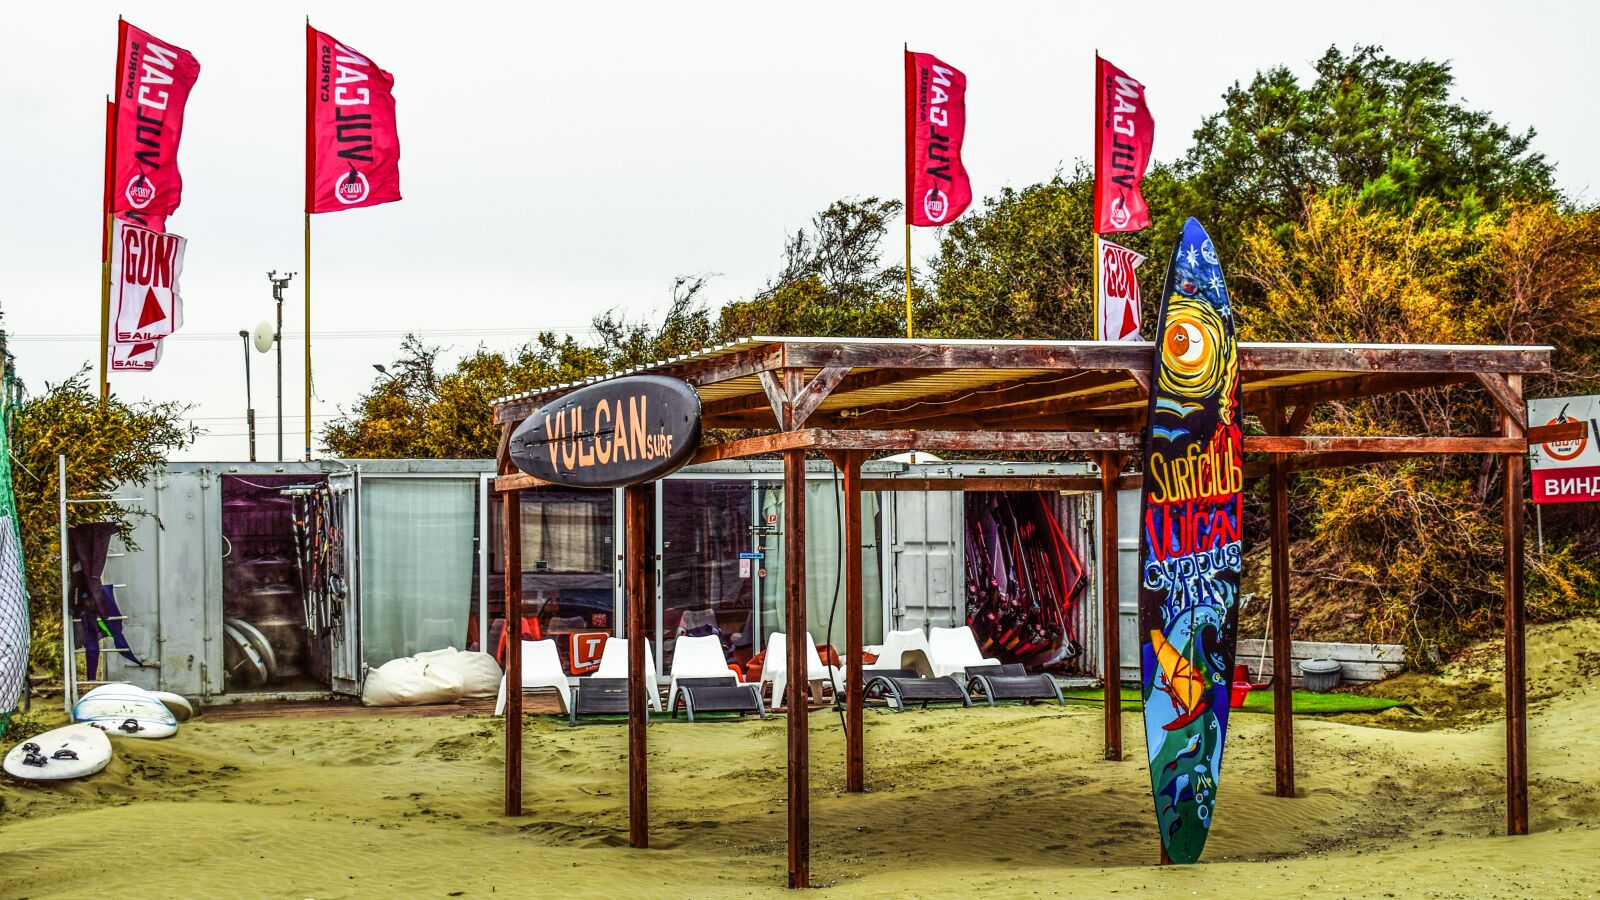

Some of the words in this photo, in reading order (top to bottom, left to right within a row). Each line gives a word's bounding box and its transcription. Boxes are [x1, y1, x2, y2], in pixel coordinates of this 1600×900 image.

[125, 229, 174, 289] GUN
[1105, 248, 1139, 300] GUN
[114, 360, 154, 368] SAILS
[545, 395, 647, 474] VULCAN
[646, 434, 673, 460] SURF
[586, 639, 601, 657] T
